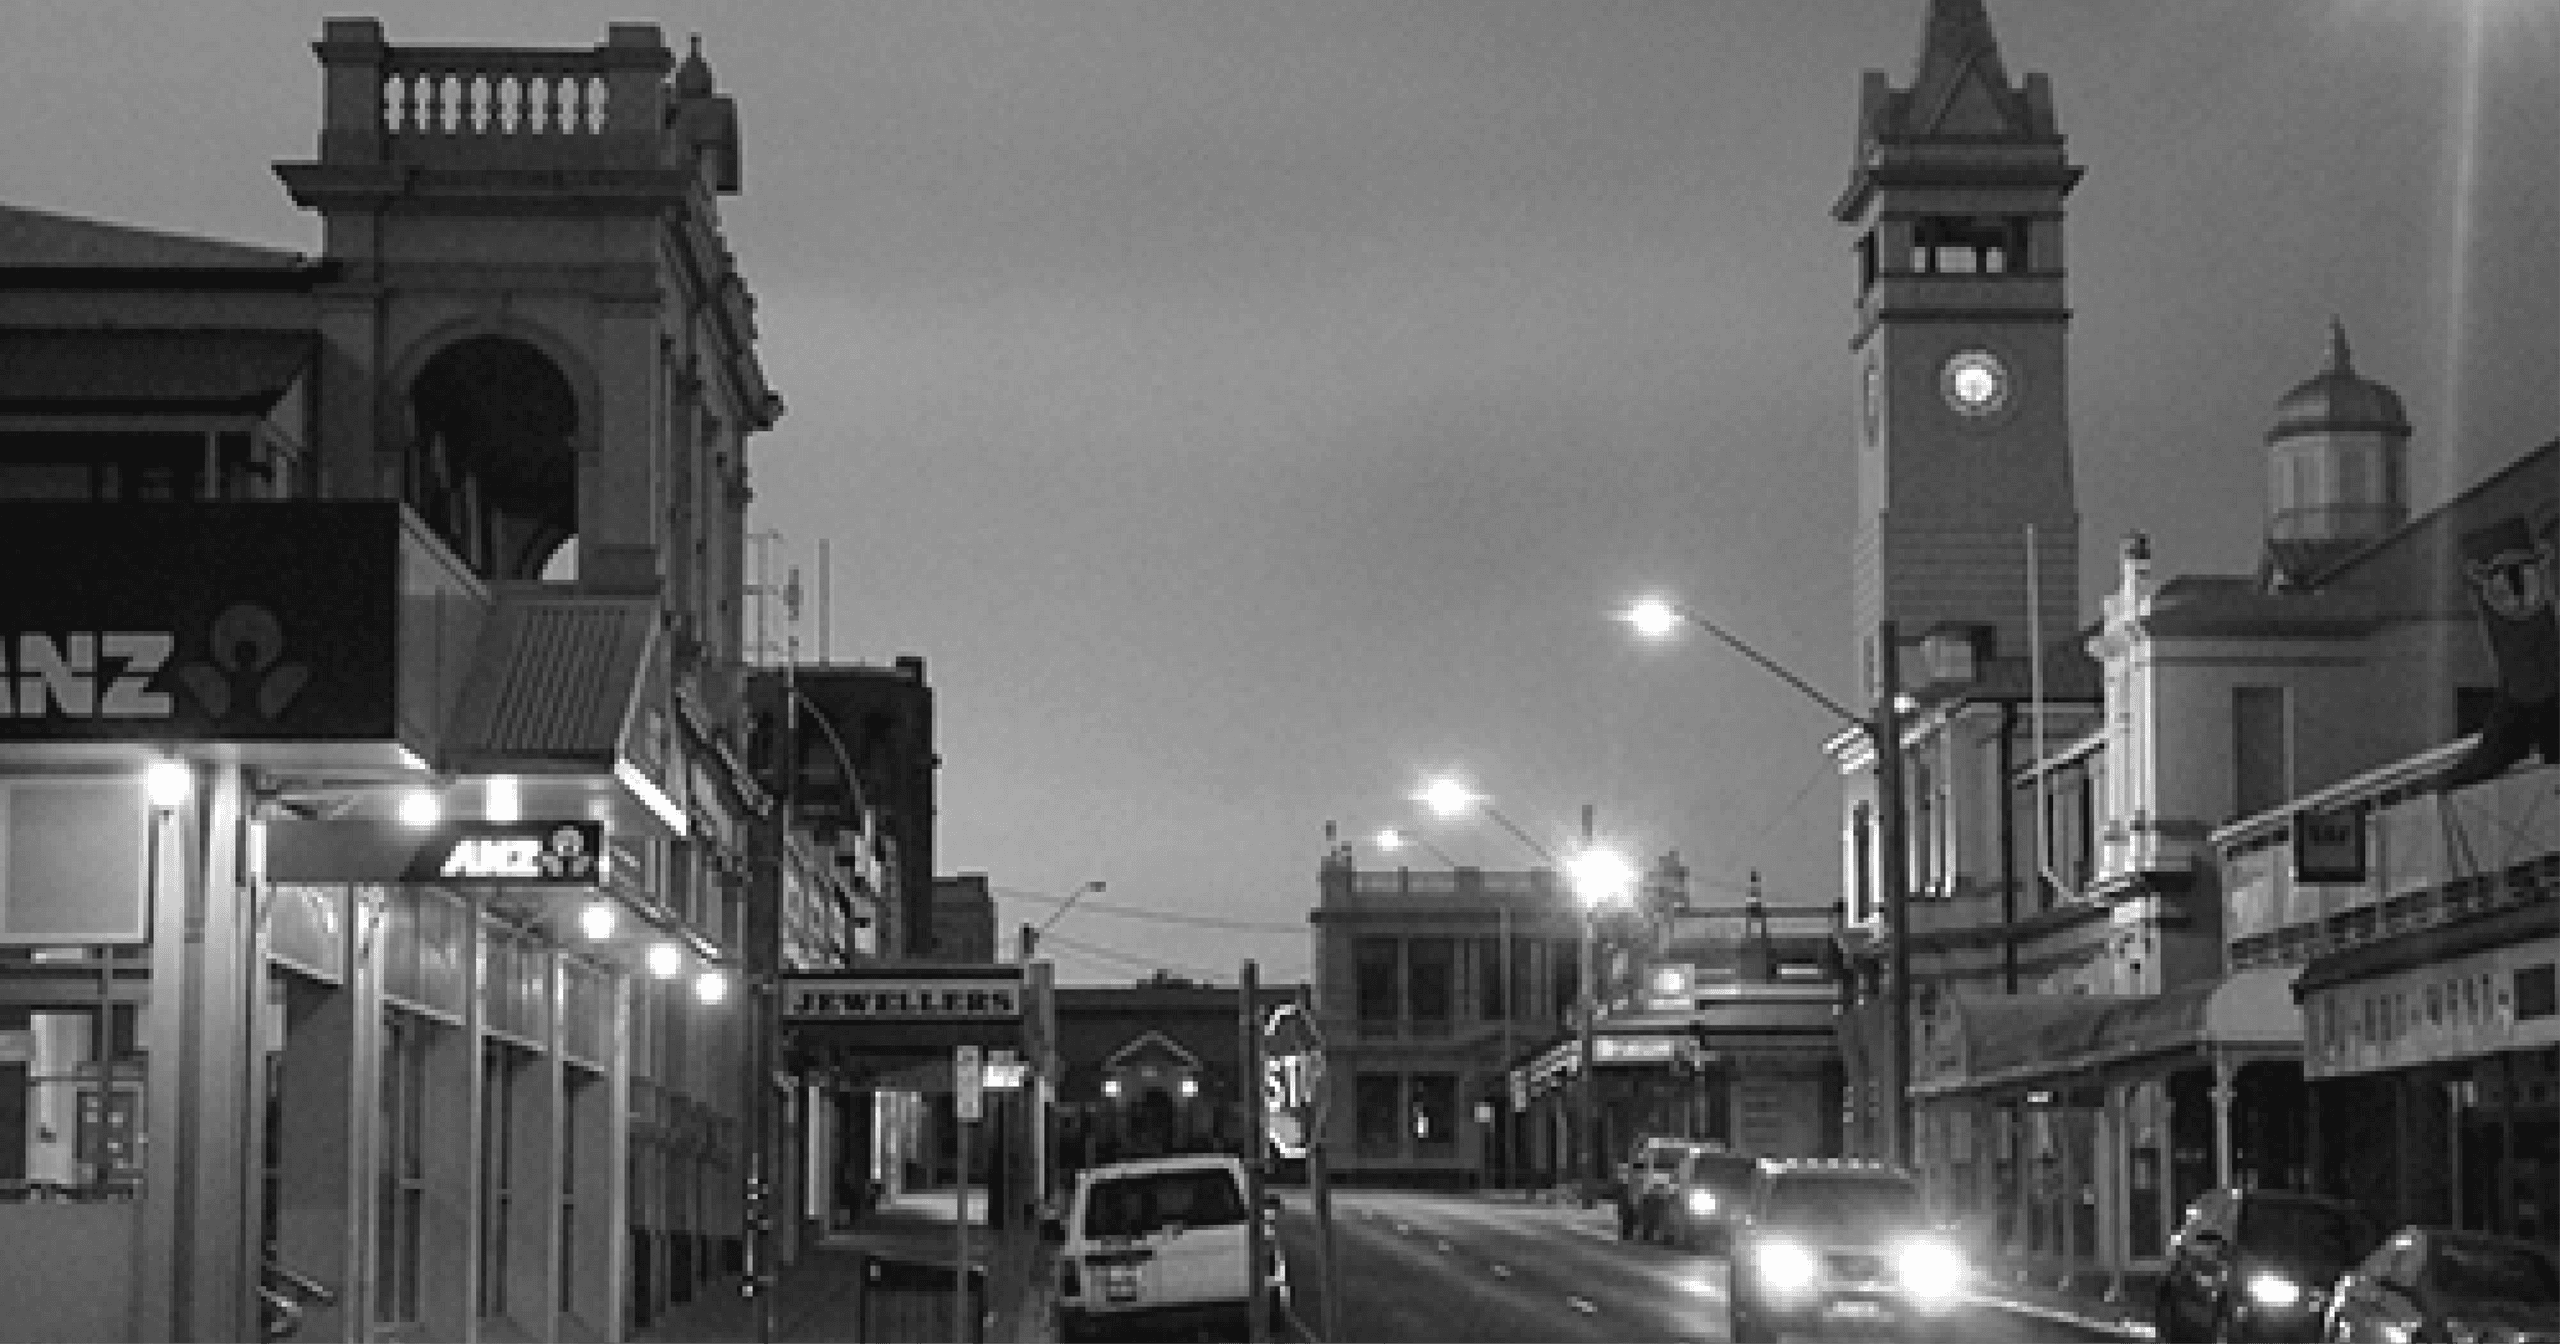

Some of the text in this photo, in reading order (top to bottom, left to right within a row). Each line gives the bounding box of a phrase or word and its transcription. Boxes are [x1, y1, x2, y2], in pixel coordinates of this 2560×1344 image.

[0, 631, 174, 718] NZ
[440, 837, 542, 877] ANZ
[794, 989, 1014, 1016] JEWELLERS
